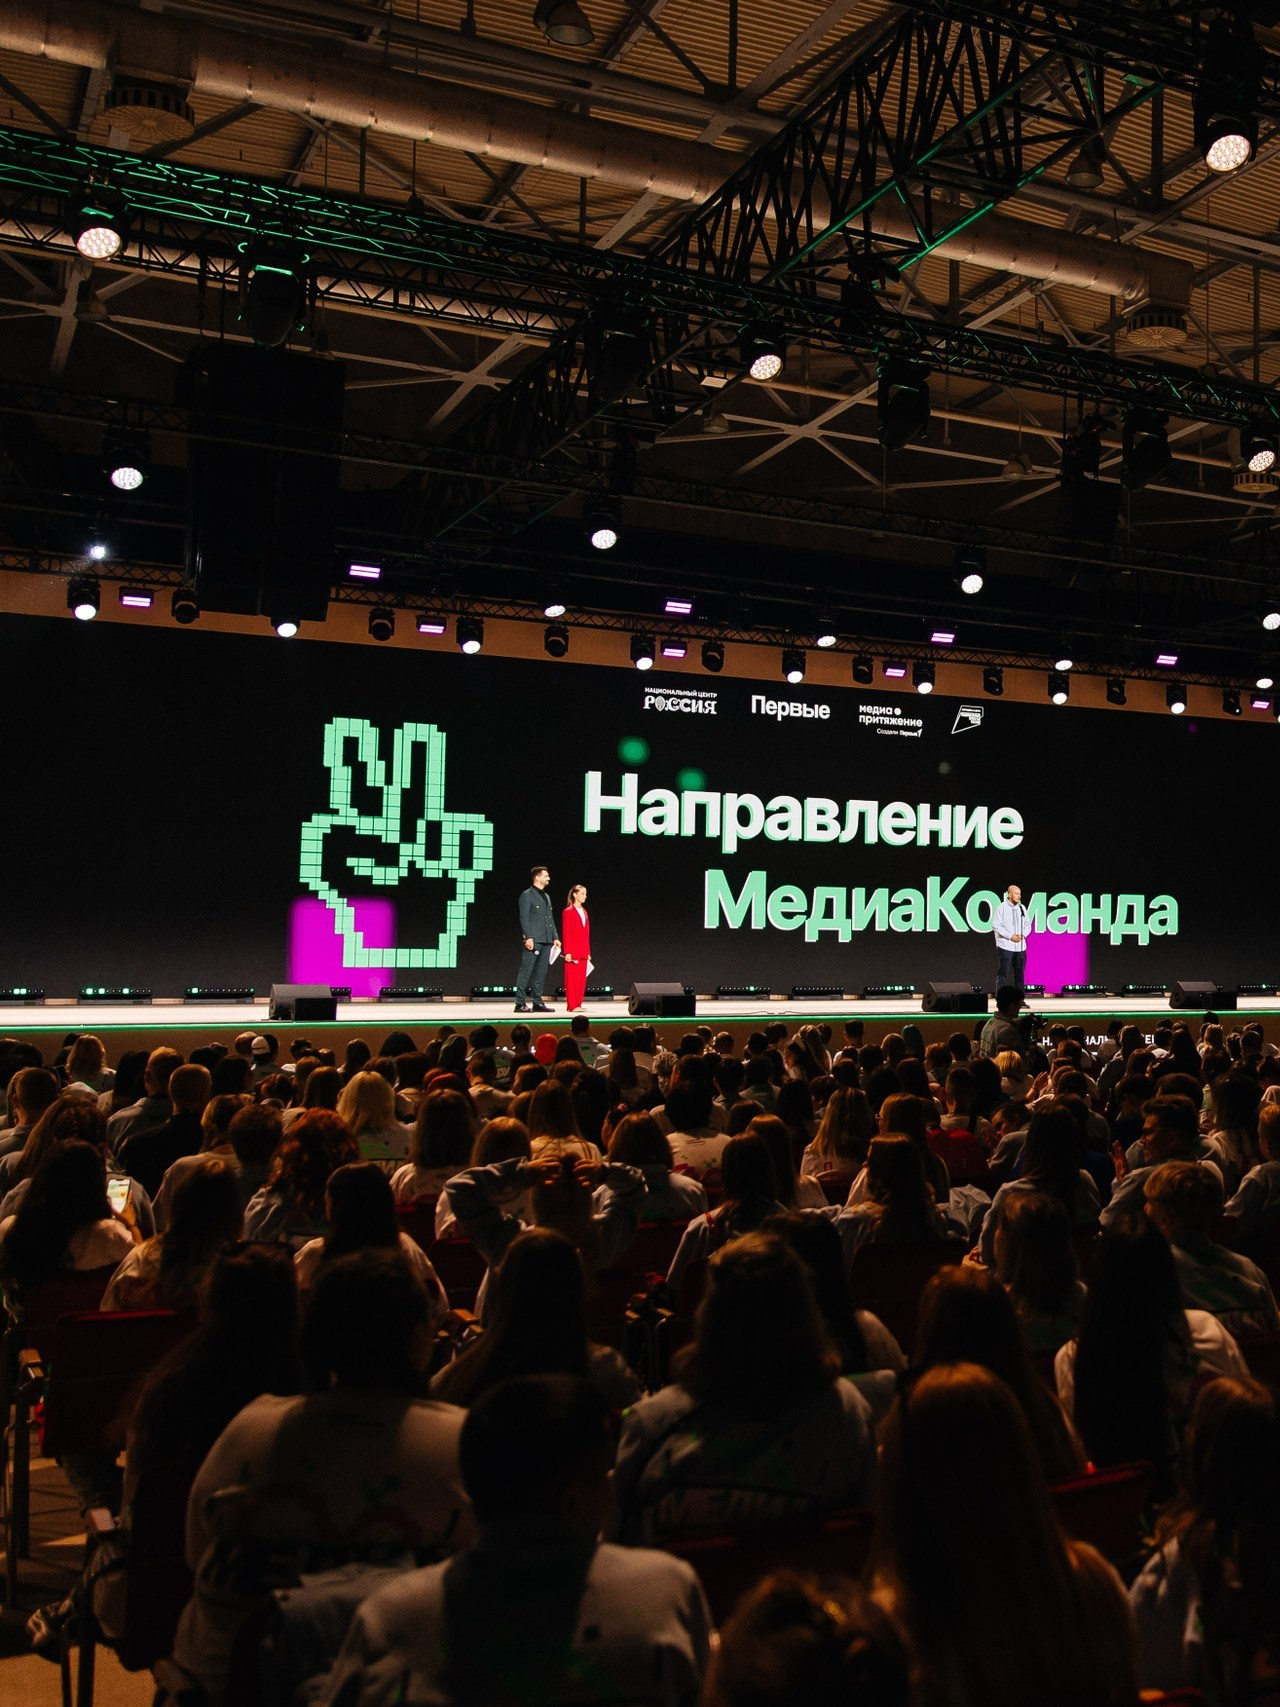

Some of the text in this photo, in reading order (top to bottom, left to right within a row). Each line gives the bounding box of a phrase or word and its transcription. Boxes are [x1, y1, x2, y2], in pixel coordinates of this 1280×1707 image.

[643, 695, 718, 715] РОССИЯ
[751, 694, 831, 722] Первые
[859, 704, 893, 716] медиа
[858, 714, 923, 728] притяжение
[583, 770, 1025, 854] Направление
[704, 868, 1179, 946] МедиаКоманда
